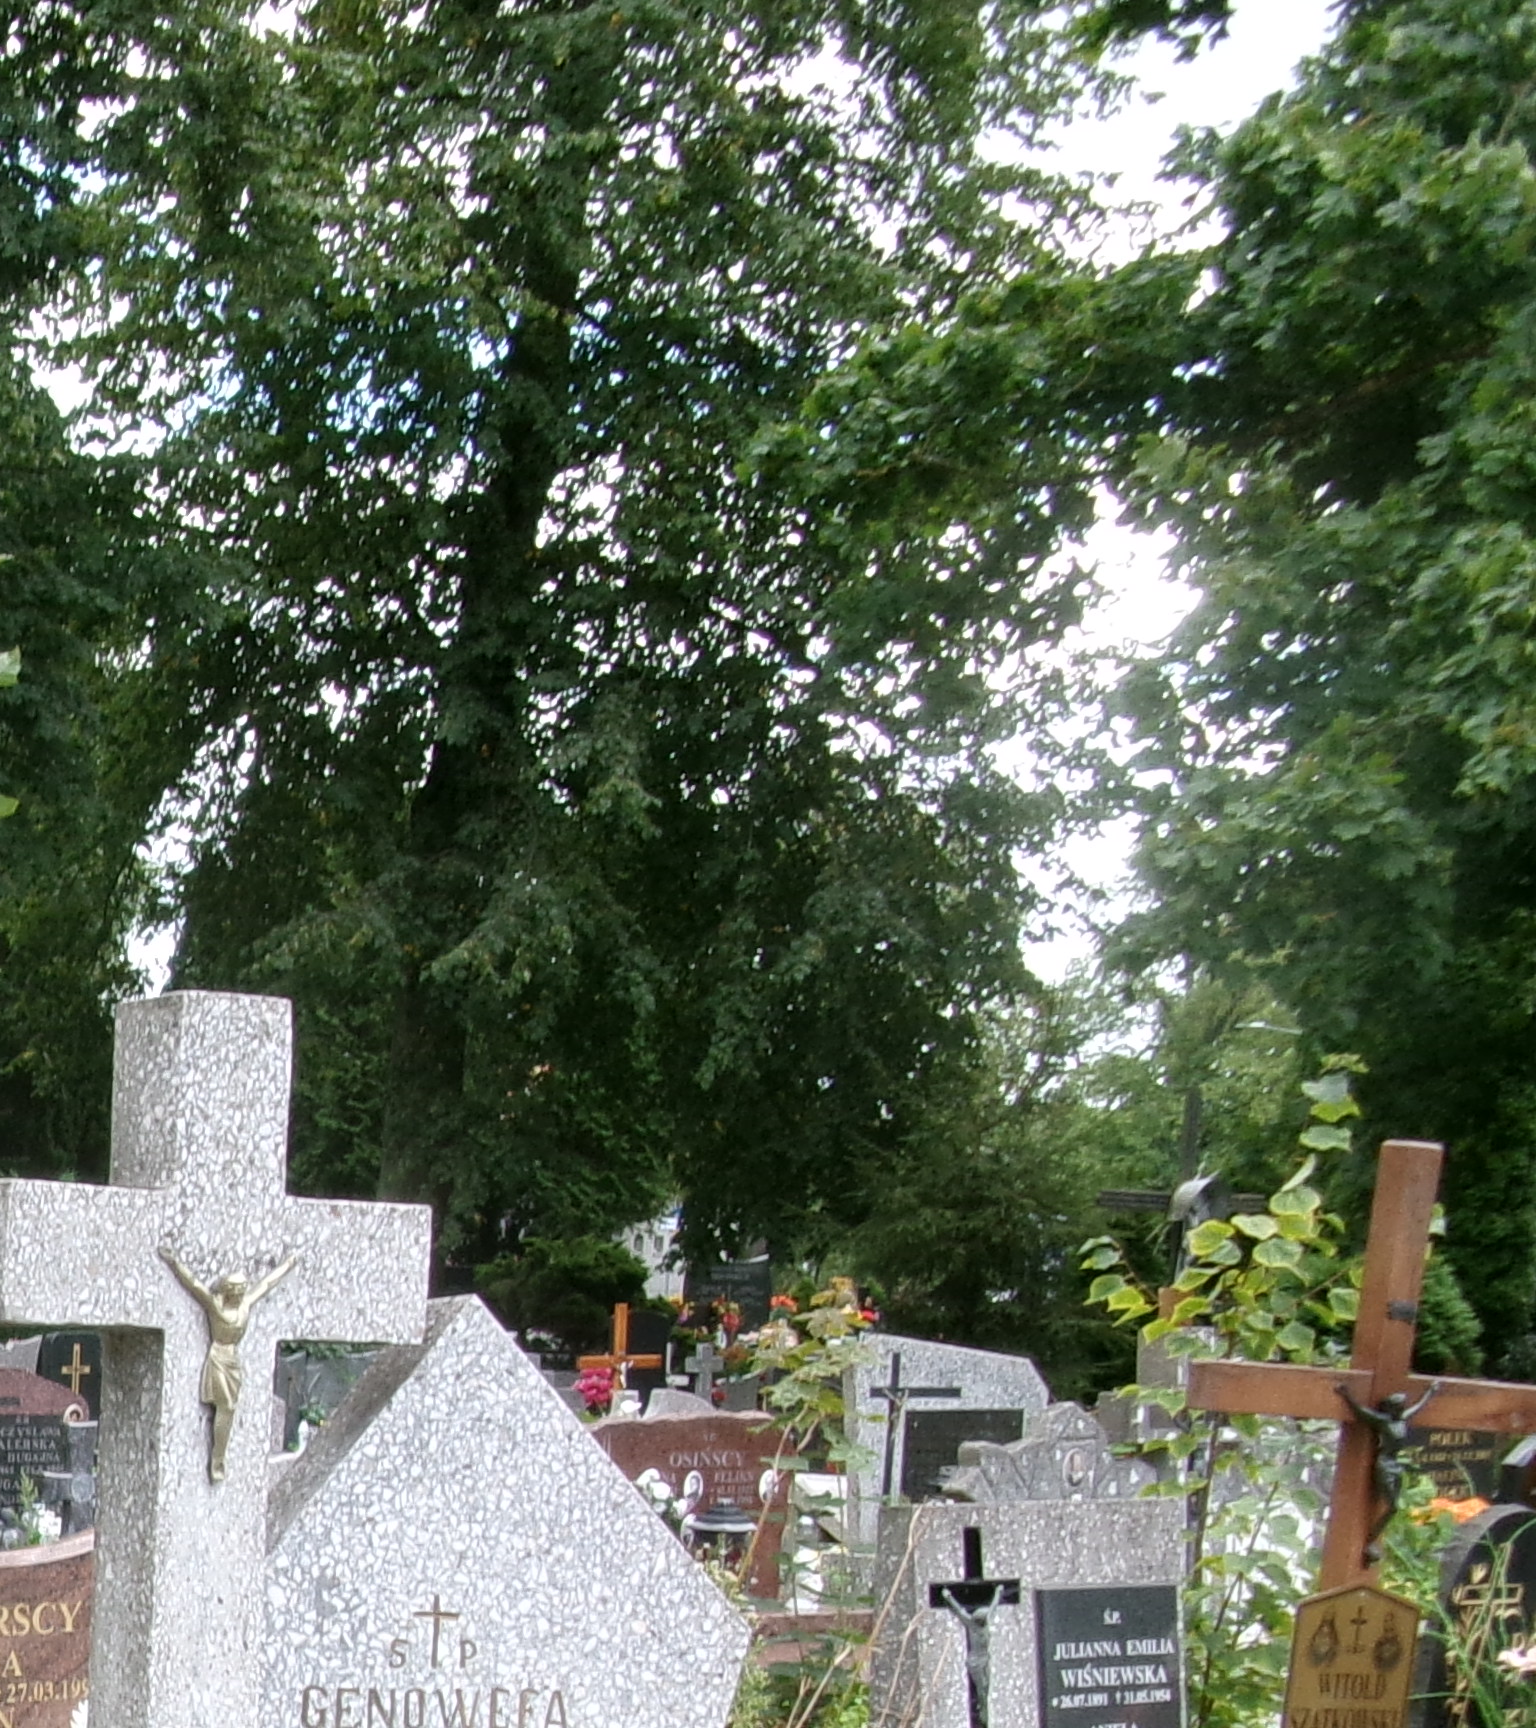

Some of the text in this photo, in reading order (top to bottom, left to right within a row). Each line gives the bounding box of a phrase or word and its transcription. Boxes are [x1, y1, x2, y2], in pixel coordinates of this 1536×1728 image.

[460, 1639, 478, 1669] P
[1053, 1638, 1175, 1661] JULIANNA EMILIA
[1061, 1663, 1168, 1688] WIŚNIEWSKA
[1319, 1673, 1388, 1700] WITOLD
